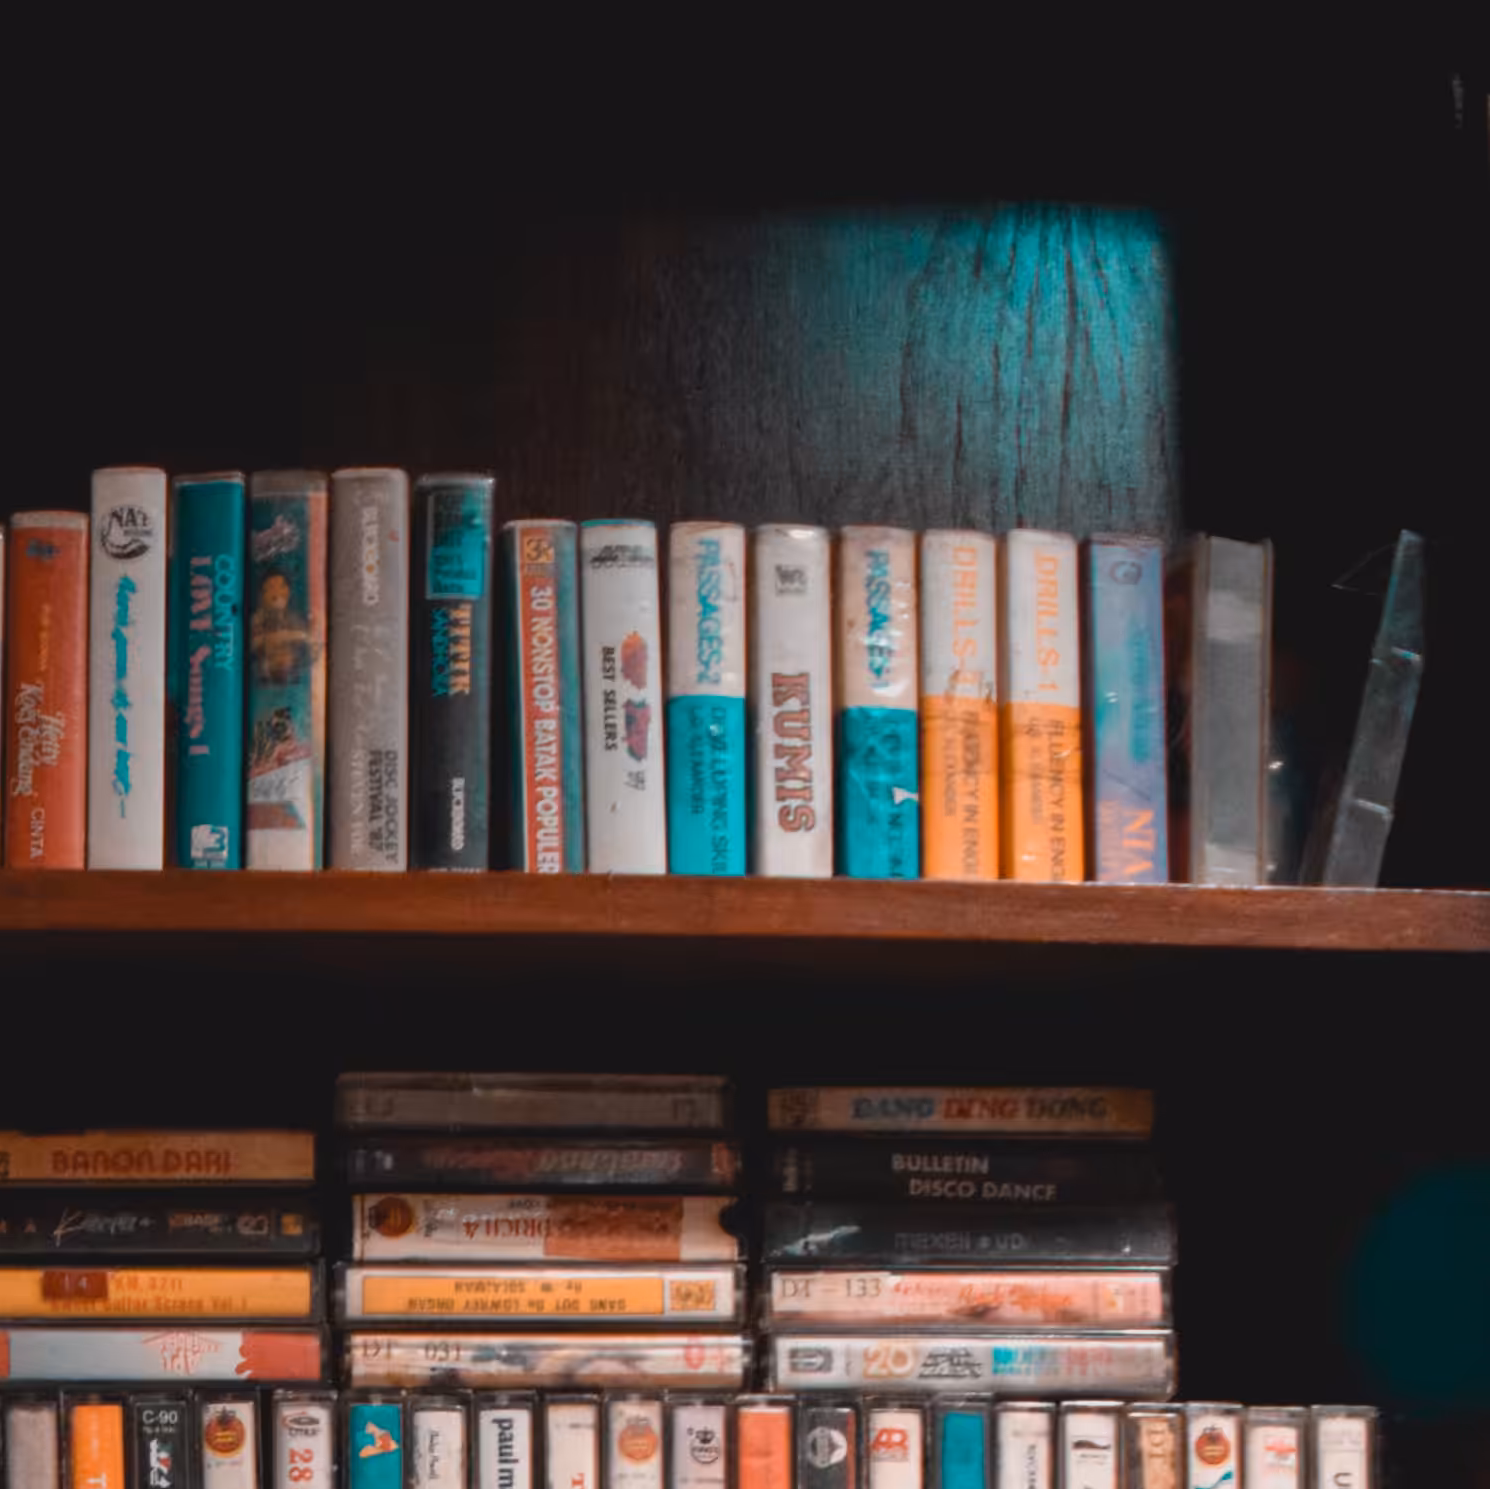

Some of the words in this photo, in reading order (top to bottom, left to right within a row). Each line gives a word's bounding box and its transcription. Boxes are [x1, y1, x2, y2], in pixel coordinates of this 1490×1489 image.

[214, 554, 235, 672] COUNTRY
[530, 586, 551, 610] 30
[531, 617, 557, 713] NONSTOP
[602, 647, 617, 681] BEST
[602, 690, 617, 751] SELLERS
[534, 719, 558, 780] BATAK
[772, 673, 815, 833] KUMIS
[891, 1154, 989, 1174] BULLETIN
[909, 1178, 974, 1200] DISCO
[981, 1178, 1058, 1200] DANCE
[493, 1418, 519, 1464] paul
